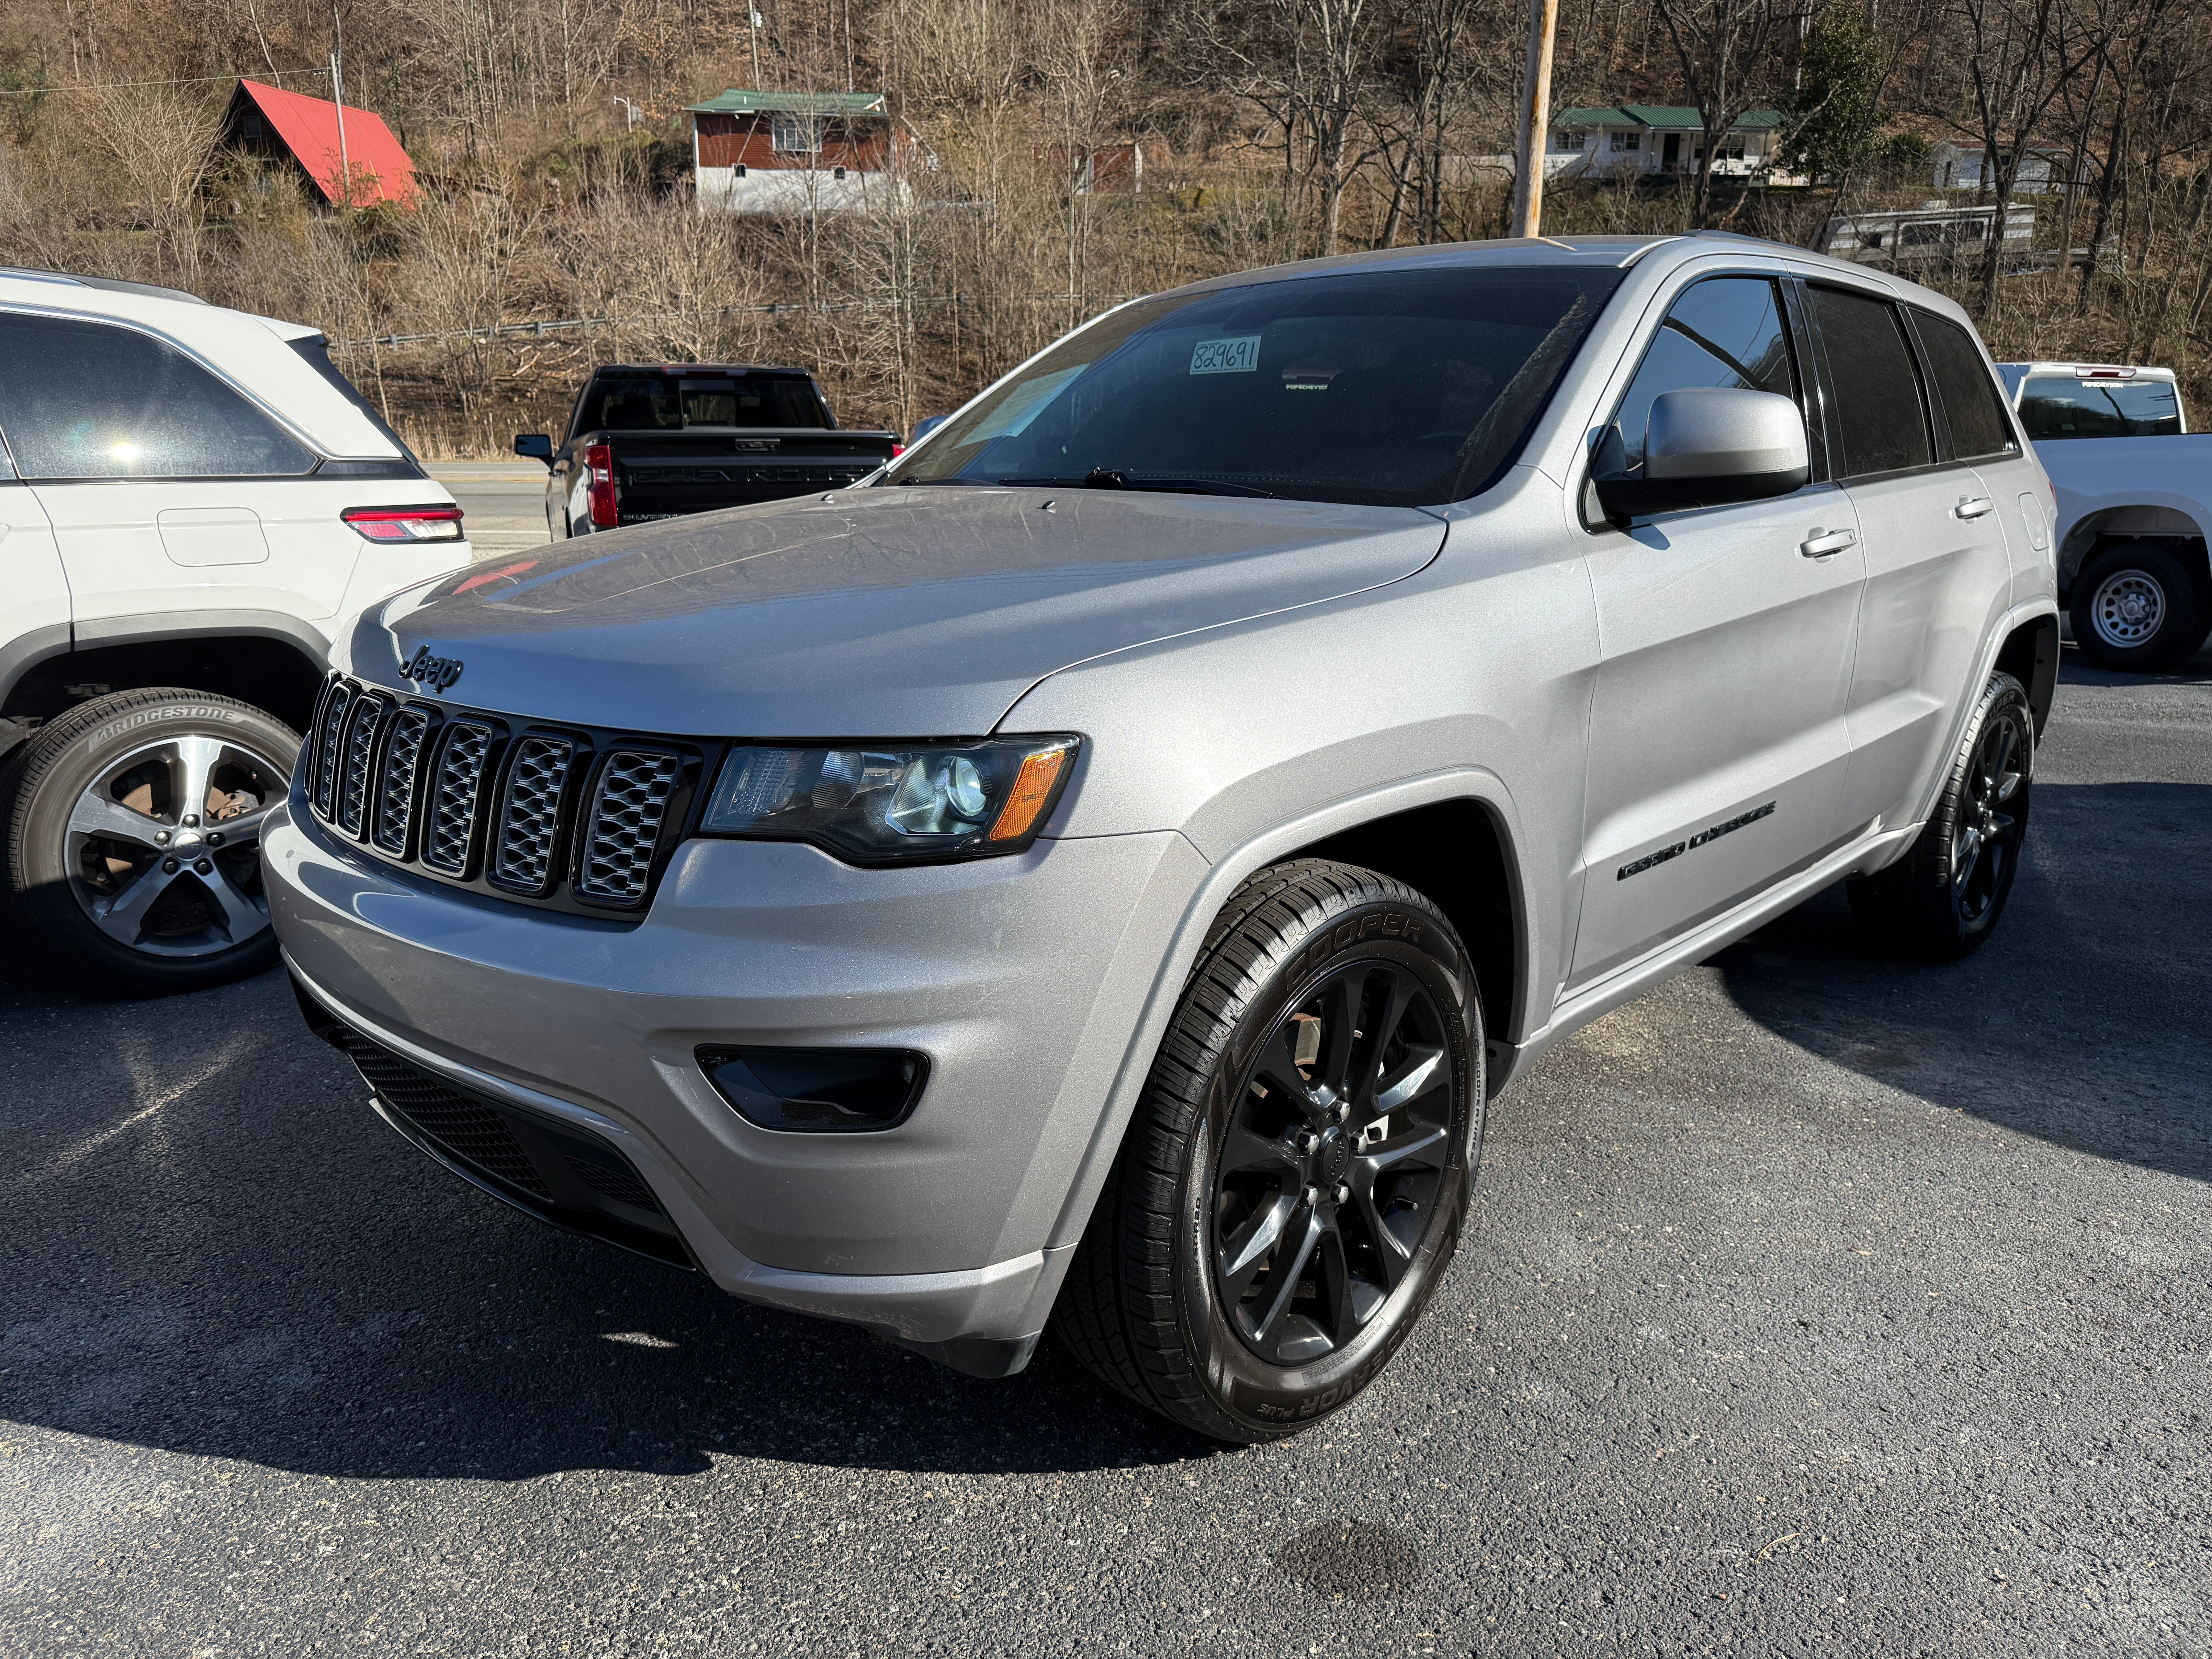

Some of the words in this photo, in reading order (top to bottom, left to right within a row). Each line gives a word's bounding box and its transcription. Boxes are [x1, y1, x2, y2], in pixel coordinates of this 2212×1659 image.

[1194, 341, 1255, 369] 829691
[634, 469, 874, 482] CHEVROLE
[398, 645, 464, 694] Jeep
[98, 706, 235, 742] BRIDGESTONE
[1617, 842, 1686, 881] GRAND
[1689, 800, 1776, 850] CHEROKEE
[1286, 914, 1425, 993] COOPER
[1257, 1403, 1295, 1418] PLUS
